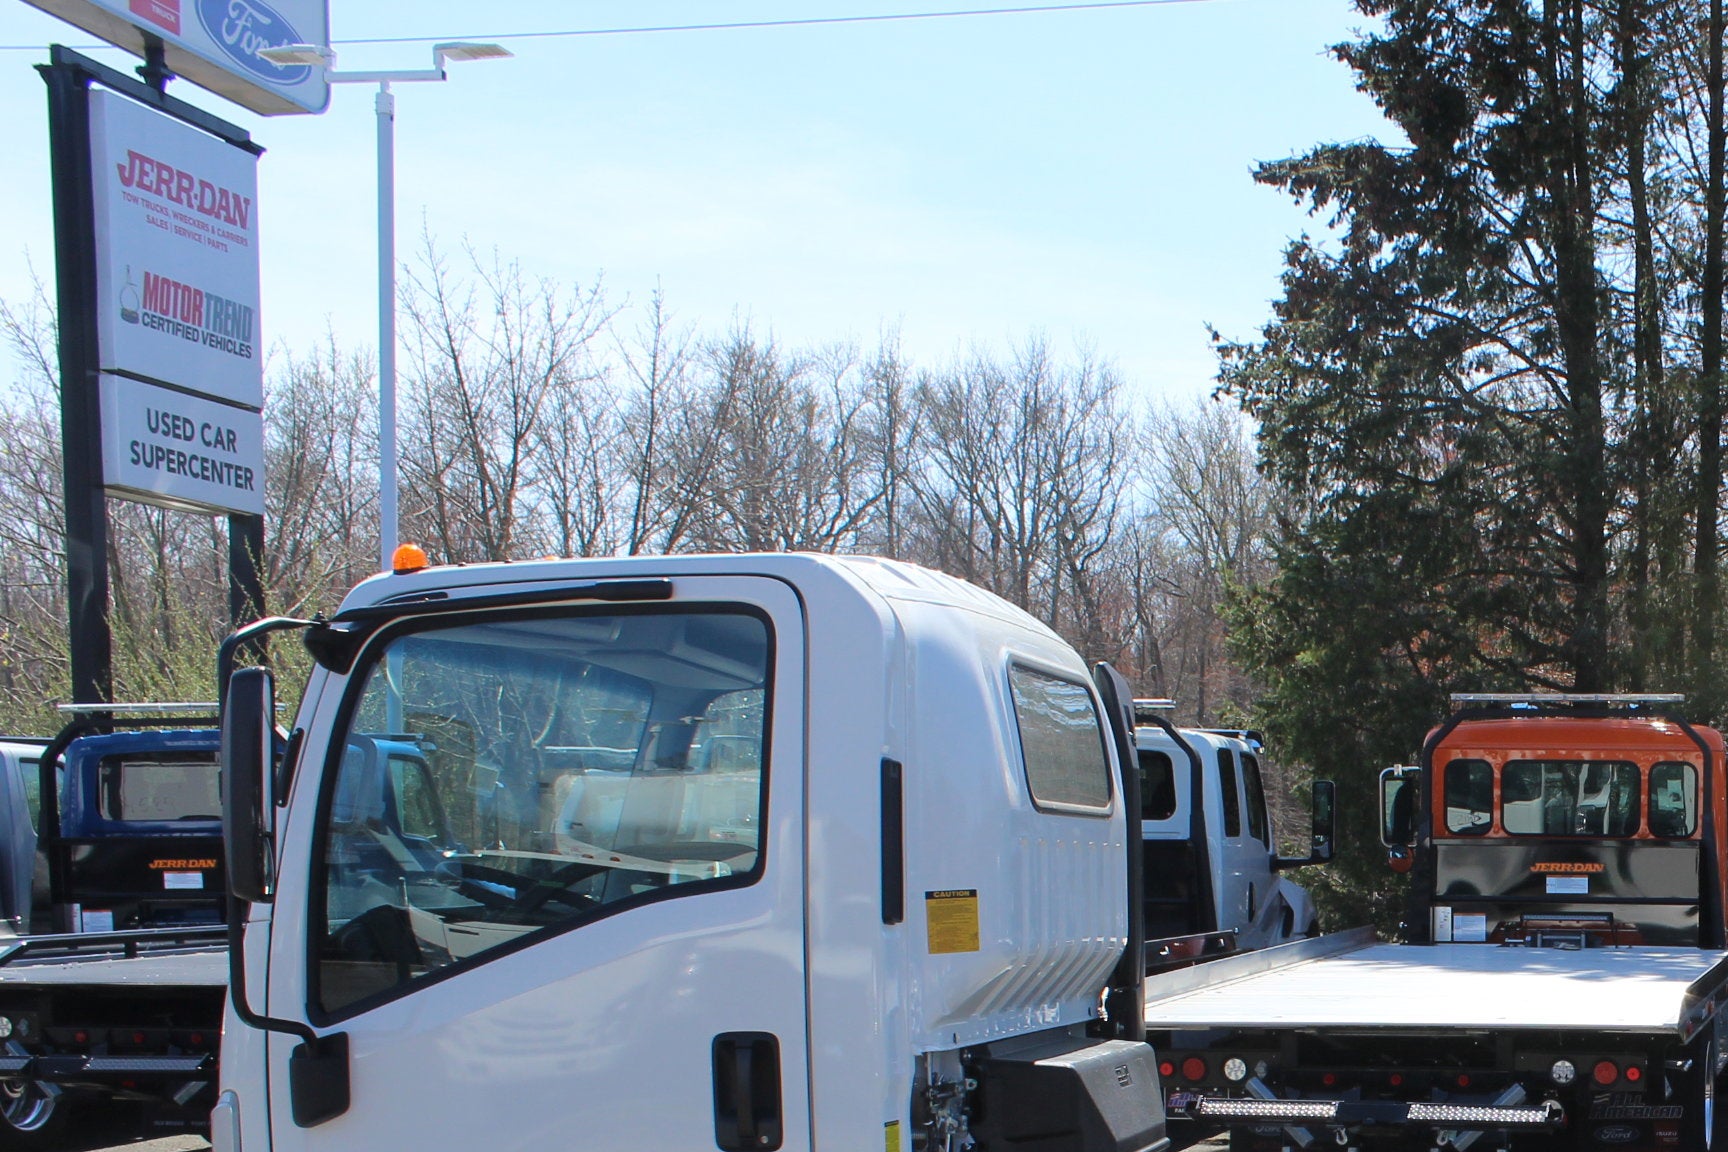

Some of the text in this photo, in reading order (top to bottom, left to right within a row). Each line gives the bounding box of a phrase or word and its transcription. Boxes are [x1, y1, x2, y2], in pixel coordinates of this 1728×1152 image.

[151, 5, 177, 23] TRUCK
[121, 190, 139, 206] TOW
[172, 210, 209, 233] WRECKERS
[210, 225, 217, 235] &
[217, 228, 249, 247] CARRIERS
[145, 214, 229, 252] SALES SERVICE PARTS
[141, 312, 252, 360] CERTIFIED VEHICLES
[147, 407, 237, 453] USED CAR
[130, 440, 254, 491] SUPERCENTER
[933, 890, 970, 898] CAUTION
[1600, 1128, 1633, 1140] Ford
